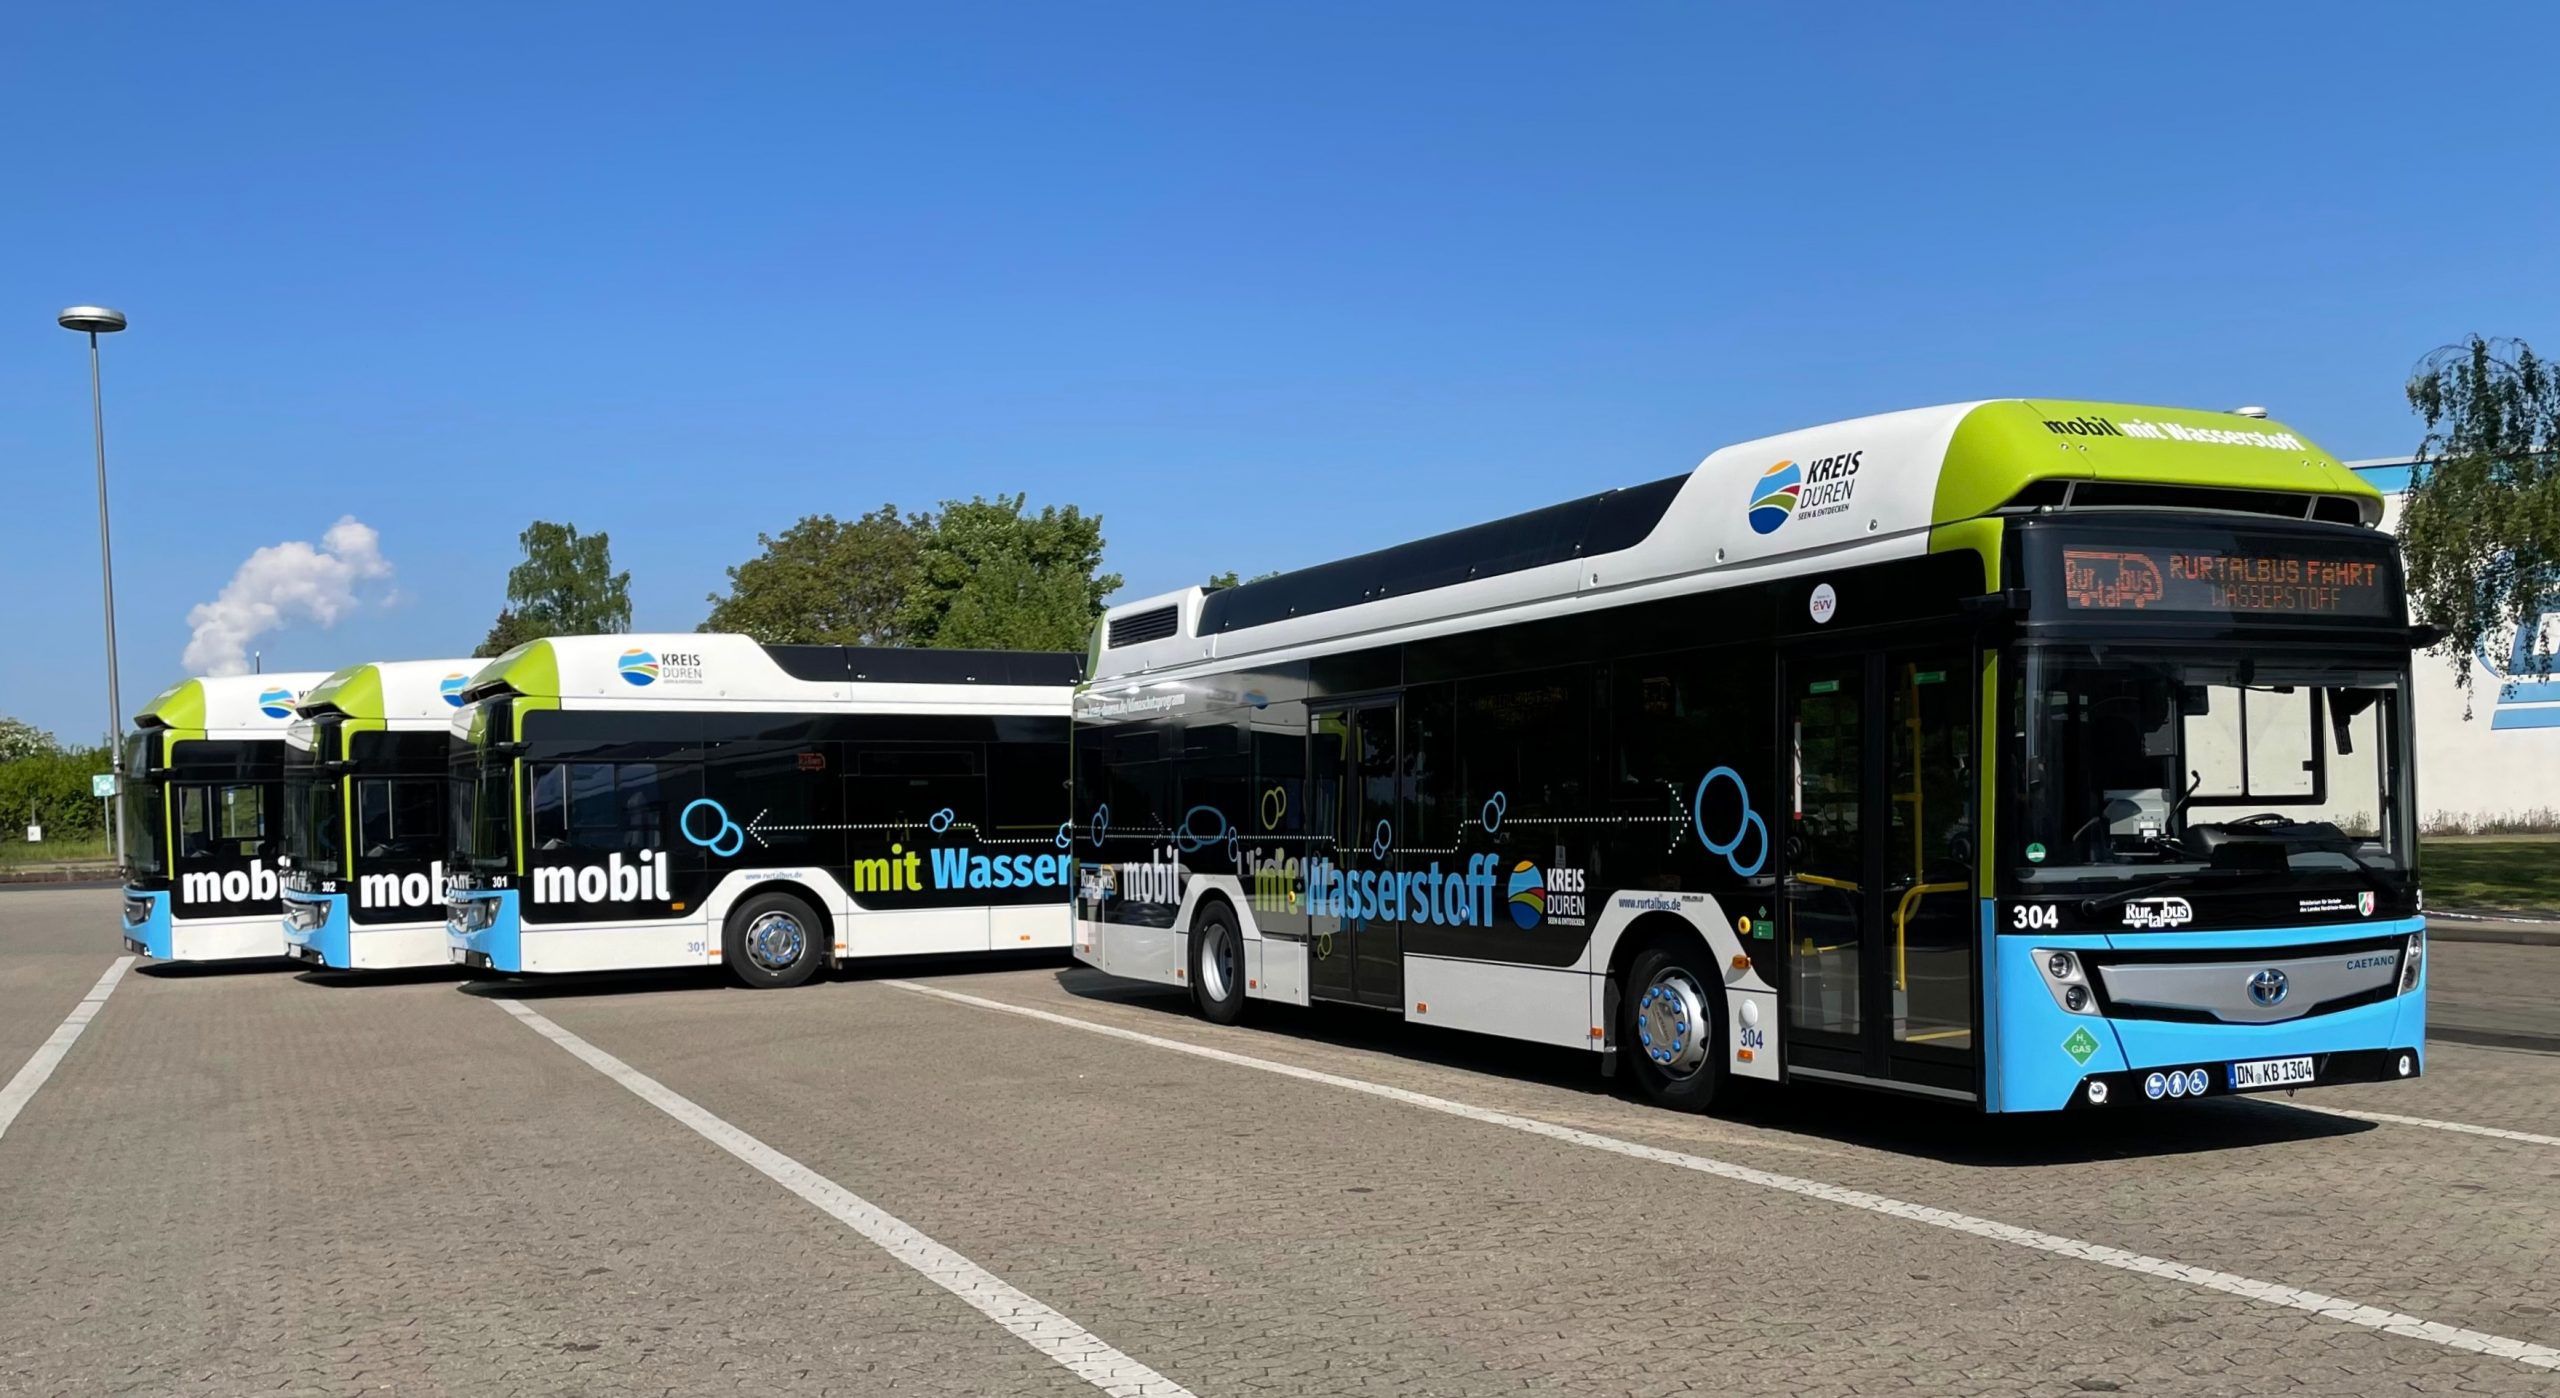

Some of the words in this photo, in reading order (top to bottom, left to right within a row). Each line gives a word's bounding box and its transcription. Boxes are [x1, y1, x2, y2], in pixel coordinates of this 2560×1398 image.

[2042, 416, 2124, 437] mobil
[2118, 418, 2168, 440] mit
[2158, 421, 2306, 451] Wasserstoff
[1806, 450, 1863, 484] KREIS
[1800, 479, 1855, 509] DÜREN
[1798, 511, 1812, 520] SEEN
[1812, 510, 1817, 518] &
[1817, 503, 1850, 517] ENTDECKEN
[2169, 555, 2299, 583] RURTALBUS
[2306, 560, 2376, 587] FÄHRT
[2211, 584, 2341, 610] WASSERSTOFF
[661, 653, 701, 666] KREIS
[663, 667, 702, 678] DÜREN
[182, 855, 291, 903] mobi
[533, 849, 671, 903] mobil
[853, 843, 923, 892] mit
[930, 847, 1072, 889] Wasser
[1547, 868, 1585, 892] KREIS
[360, 860, 453, 908] mob
[492, 876, 507, 888] 301
[1123, 845, 1180, 905] mobil
[1255, 847, 1298, 915] mit
[1303, 853, 1499, 927] Wasserstoff
[1547, 894, 1585, 916] DÜREN
[1618, 897, 1681, 911] www.rurtalbus.de
[2013, 904, 2059, 929] 304
[687, 941, 706, 953] 301
[2347, 955, 2395, 970] CAETANO
[1740, 1028, 1763, 1049] 304
[2071, 1045, 2091, 1054] GAS
[2237, 1064, 2254, 1085] DN
[2263, 1063, 2280, 1083] KB
[2282, 1060, 2312, 1080] 1304
